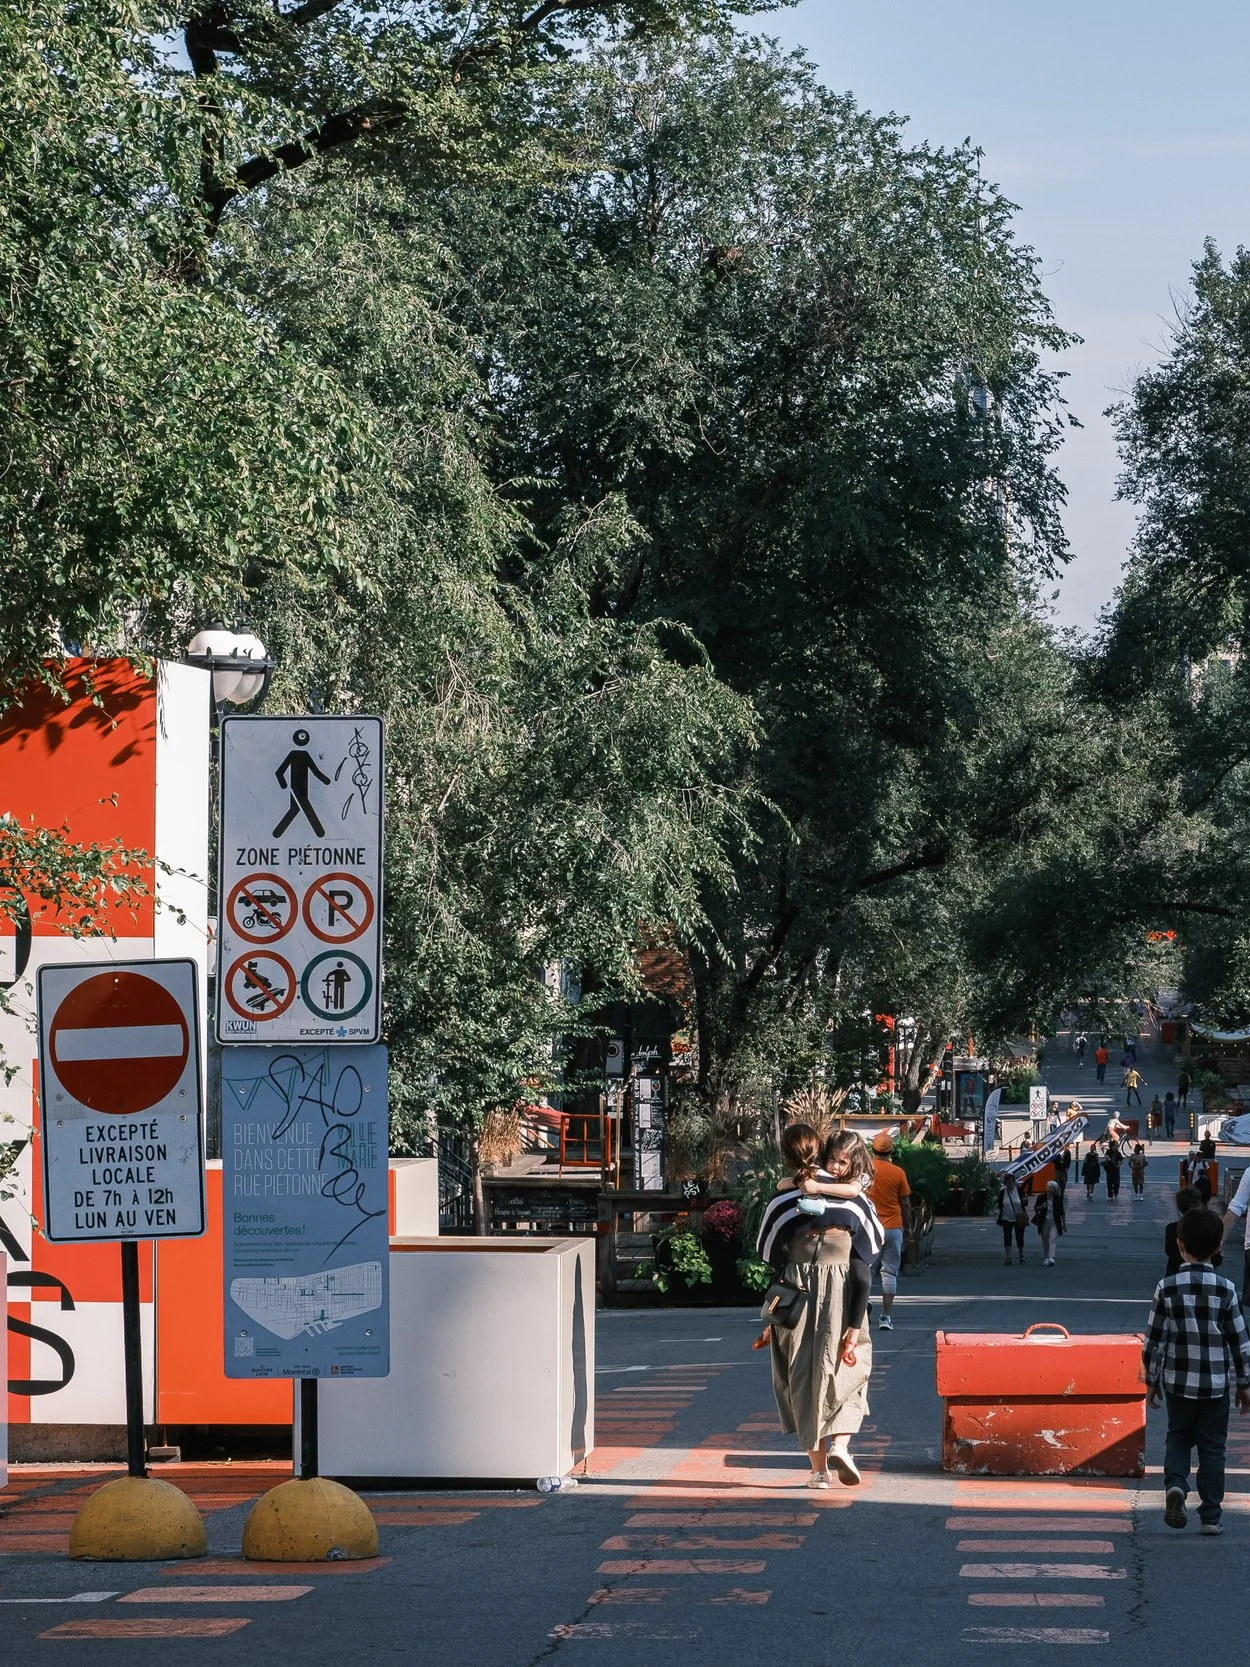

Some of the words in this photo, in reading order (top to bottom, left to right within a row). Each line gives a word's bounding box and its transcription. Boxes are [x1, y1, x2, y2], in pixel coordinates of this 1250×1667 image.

[237, 848, 279, 866] ZONE
[288, 844, 366, 866] PIÉTONNE
[226, 1021, 256, 1030] KWUN
[300, 1028, 334, 1036] EXCEPTÉ
[348, 1028, 370, 1036] SPVM
[86, 1118, 159, 1142] EXCEPTÉ
[233, 1122, 313, 1145] BIENVENUE
[80, 1144, 167, 1164] LIVRAISON
[234, 1149, 273, 1171] DANS
[337, 1142, 378, 1169] MARIE
[92, 1166, 155, 1185] LOCALE
[234, 1174, 261, 1196] RUE
[264, 1170, 329, 1196] PIÉTONNE
[74, 1190, 95, 1208] DE
[103, 1189, 122, 1206] 7h
[132, 1189, 140, 1205] À
[148, 1187, 174, 1205] 12h
[75, 1211, 107, 1229] LUN
[115, 1210, 137, 1228] AU
[145, 1208, 176, 1226] VEN
[233, 1212, 275, 1223] Bonnes
[282, 1367, 312, 1376] Montréal
